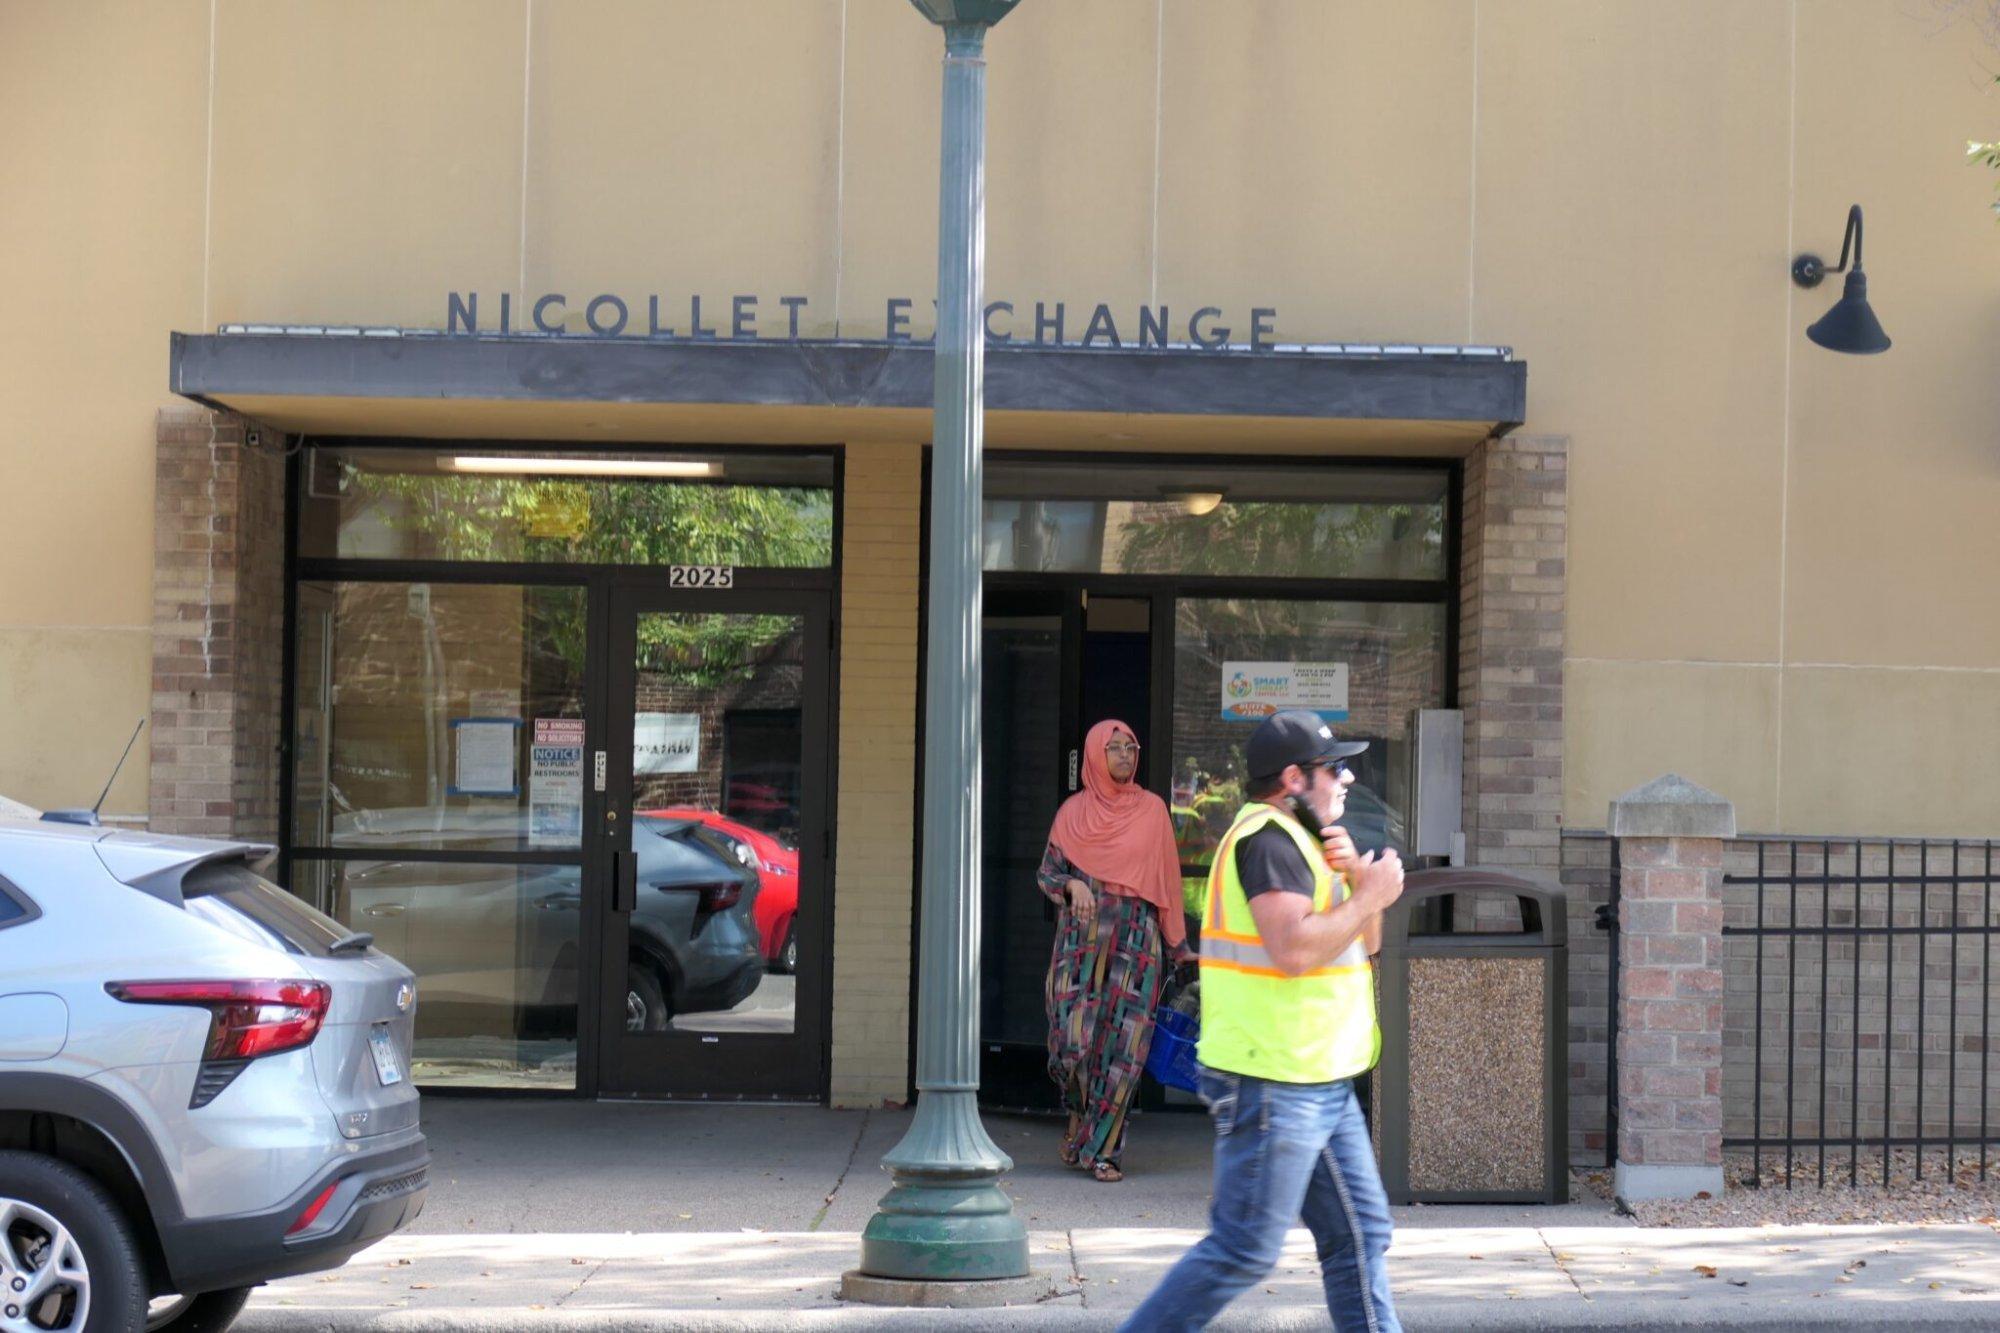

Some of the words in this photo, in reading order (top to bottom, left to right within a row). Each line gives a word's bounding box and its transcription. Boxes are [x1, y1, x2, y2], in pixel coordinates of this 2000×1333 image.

[447, 291, 809, 339] NICOLLET
[886, 298, 1277, 352] ECHANGE
[672, 567, 730, 586] 2025
[1253, 677, 1289, 685] SMART
[537, 721, 548, 730] NO
[550, 721, 583, 730] SMOKING
[537, 734, 547, 742] NO
[535, 749, 578, 760] NOTICE
